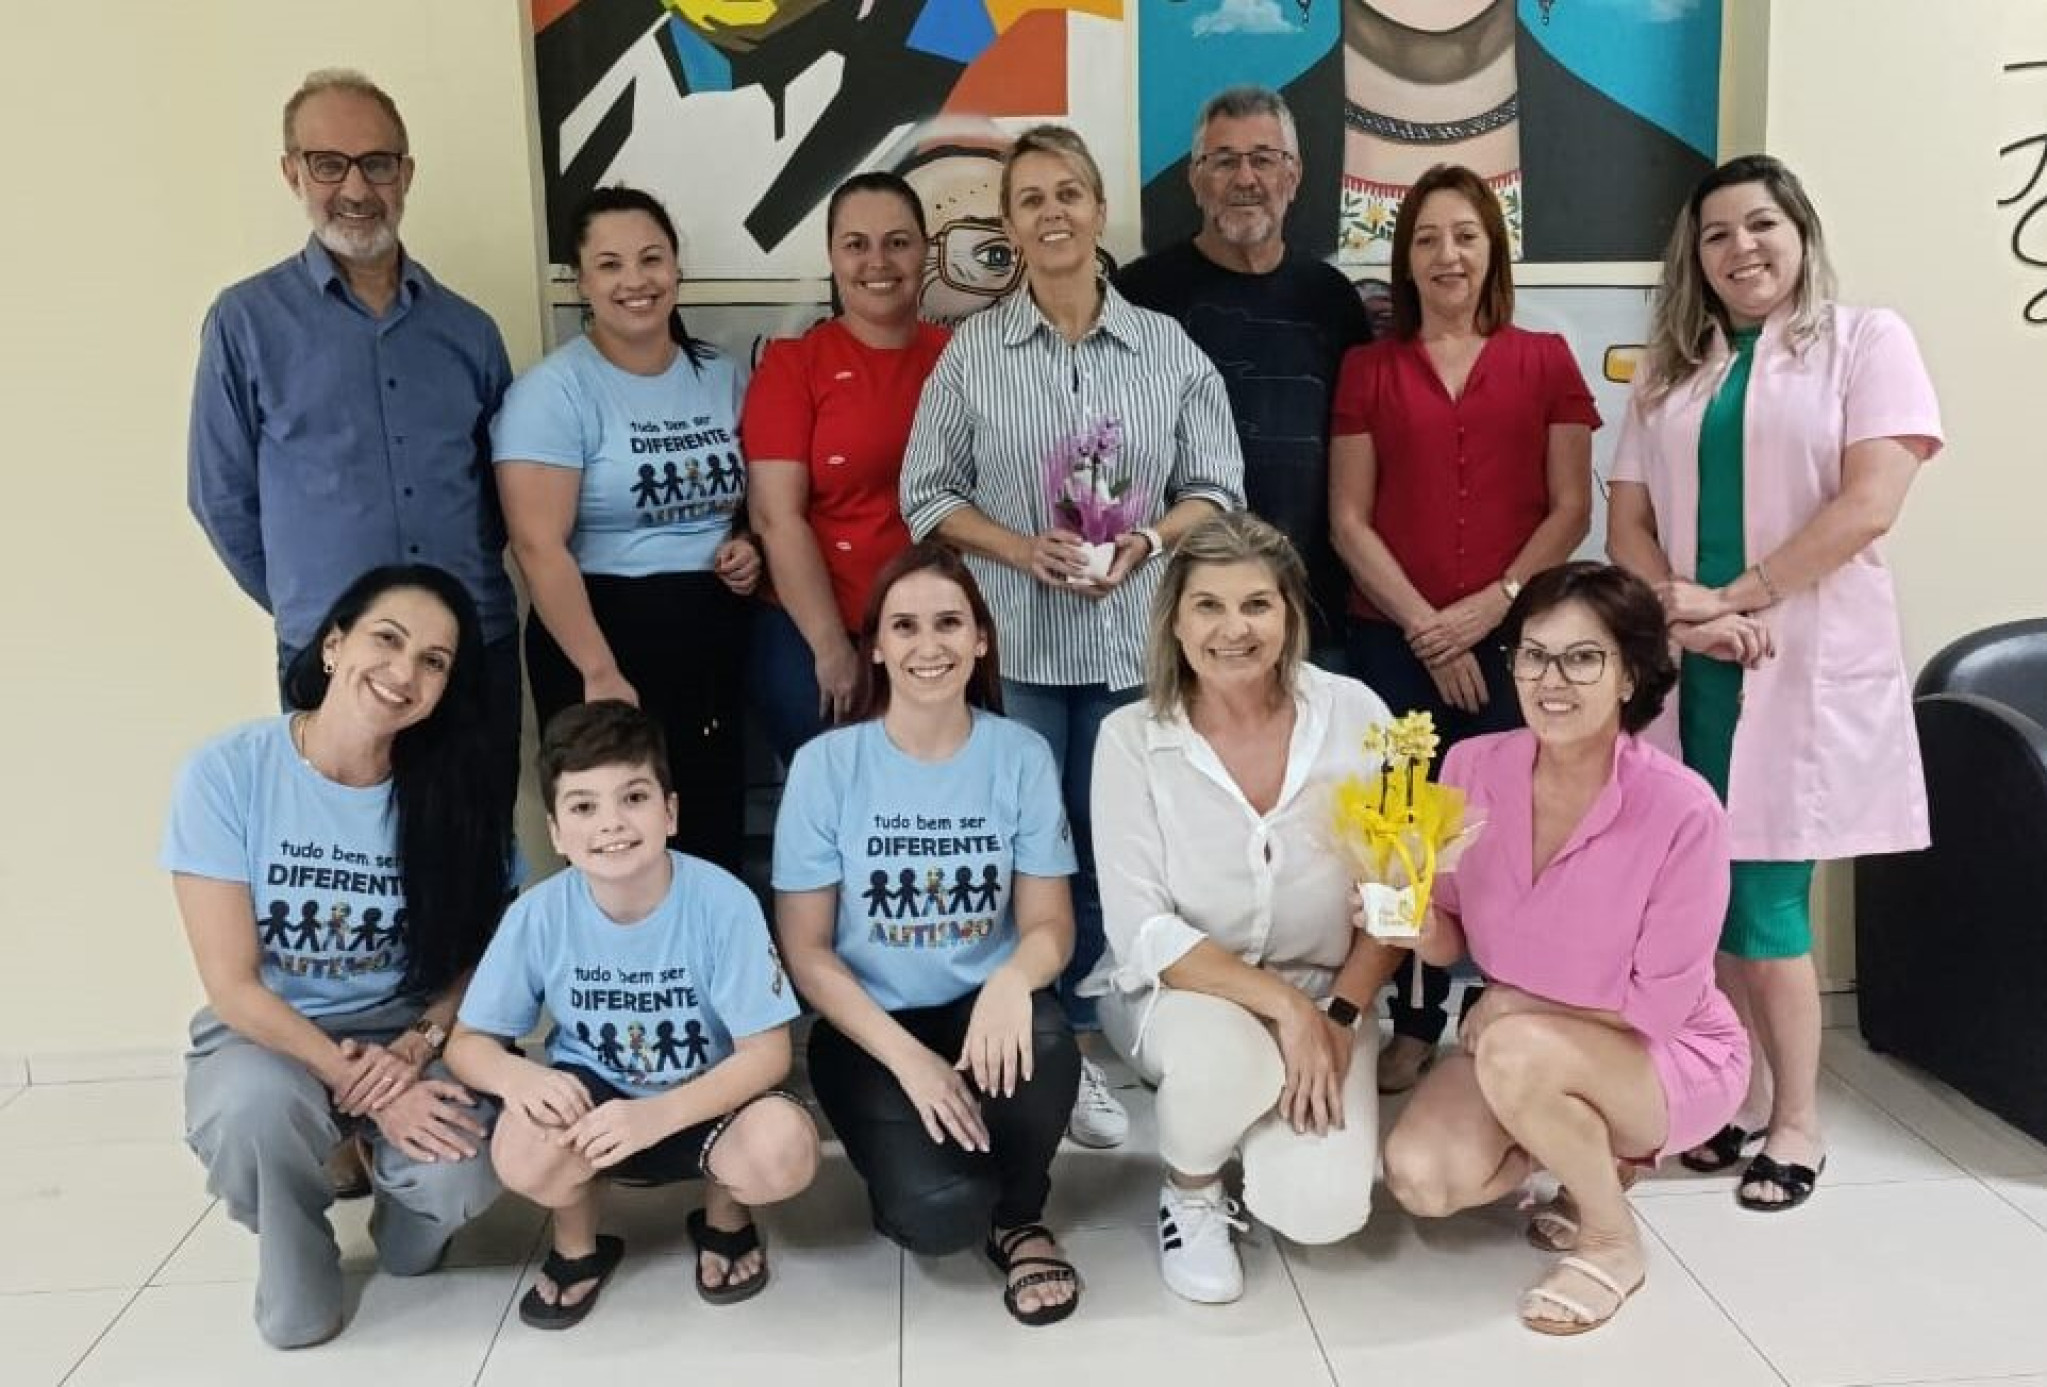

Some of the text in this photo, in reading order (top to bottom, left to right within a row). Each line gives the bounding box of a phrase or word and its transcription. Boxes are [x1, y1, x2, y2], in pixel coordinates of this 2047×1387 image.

[630, 428, 731, 453] DIFERENTE
[874, 812, 986, 830] tudo bem ser
[281, 839, 324, 858] tudo
[331, 844, 368, 866] bem
[867, 834, 1001, 857] DIFERENTE
[267, 863, 406, 896] DIFERENT
[574, 966, 611, 981] tudo
[659, 967, 686, 982] ser
[570, 987, 699, 1013] DIFERENTE
